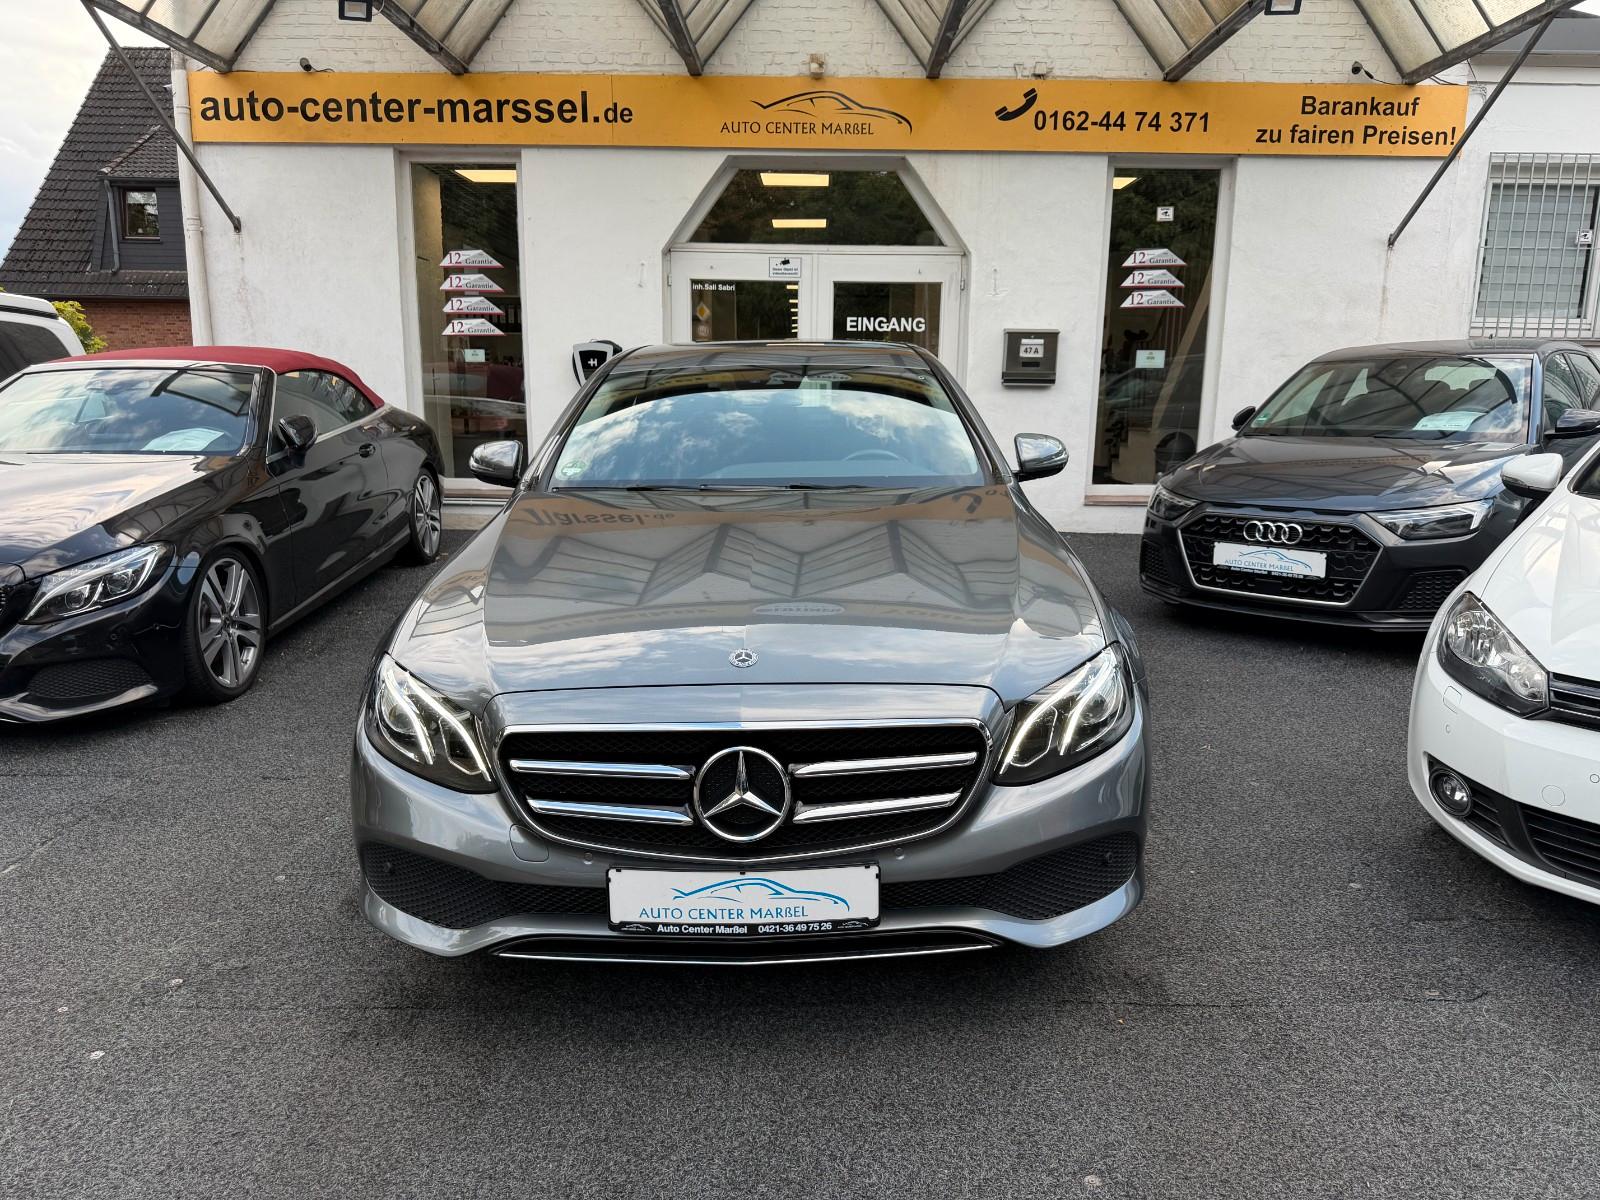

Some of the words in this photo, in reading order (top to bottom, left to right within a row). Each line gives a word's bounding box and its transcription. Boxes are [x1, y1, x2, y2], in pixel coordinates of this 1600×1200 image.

[200, 90, 633, 124] auto-center-marssel.de
[1300, 95, 1421, 117] Barankauf
[1034, 110, 1127, 132] 0162-44
[1134, 111, 1162, 132] 74
[1169, 111, 1210, 133] 371
[720, 121, 761, 134] AUTO
[765, 122, 817, 135] CENTER
[821, 122, 874, 136] MARßEL
[1255, 128, 1282, 144] zu
[1289, 124, 1354, 145] fairen
[1362, 125, 1457, 147] Preisen!
[448, 252, 462, 264] 12
[1131, 251, 1146, 264] 12
[448, 276, 462, 288] 12
[1130, 272, 1145, 284] 12
[450, 299, 464, 311] 12
[466, 304, 495, 312] Garantie
[1129, 293, 1144, 305] 12
[450, 321, 464, 333] 12
[846, 316, 926, 333] EINGANG
[1023, 346, 1033, 354] 47
[639, 906, 683, 920] AUTO
[688, 908, 745, 920] CENTER
[750, 905, 809, 919] MARßEL
[657, 924, 680, 933] Auto
[682, 924, 714, 934] Center
[715, 924, 748, 934] Marßel
[758, 924, 795, 934] 0421-36
[796, 924, 807, 932] 49
[808, 923, 820, 932] 75
[820, 922, 833, 931] 26
